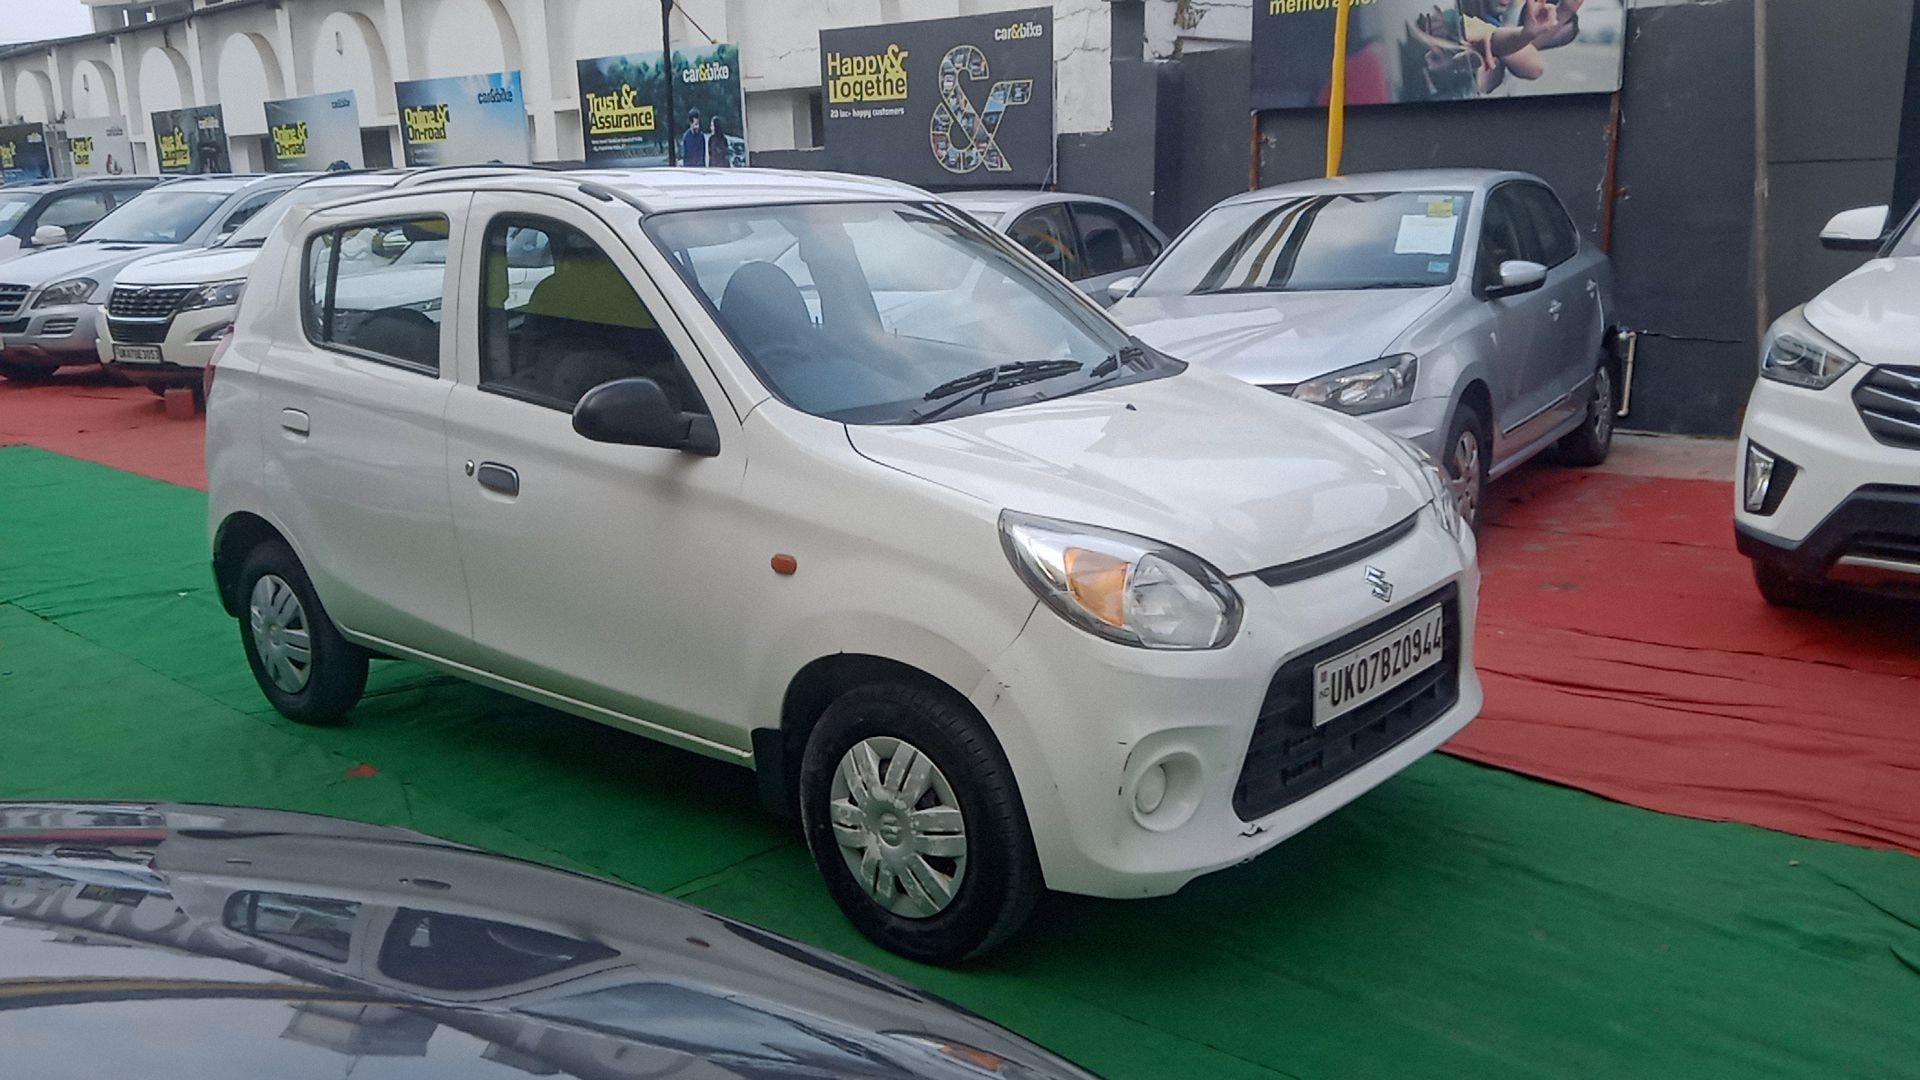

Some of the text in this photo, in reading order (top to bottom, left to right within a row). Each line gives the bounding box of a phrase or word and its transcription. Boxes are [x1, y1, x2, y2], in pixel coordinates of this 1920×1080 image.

[994, 21, 1043, 41] car&bike
[682, 61, 729, 83] car&bike
[586, 83, 638, 113] Trust &
[404, 105, 436, 126] Online
[591, 110, 653, 130] Assurance
[852, 108, 872, 118] happy
[872, 107, 905, 117] customers
[407, 123, 447, 141] On-road
[1330, 617, 1443, 707] UK07BZ0944
